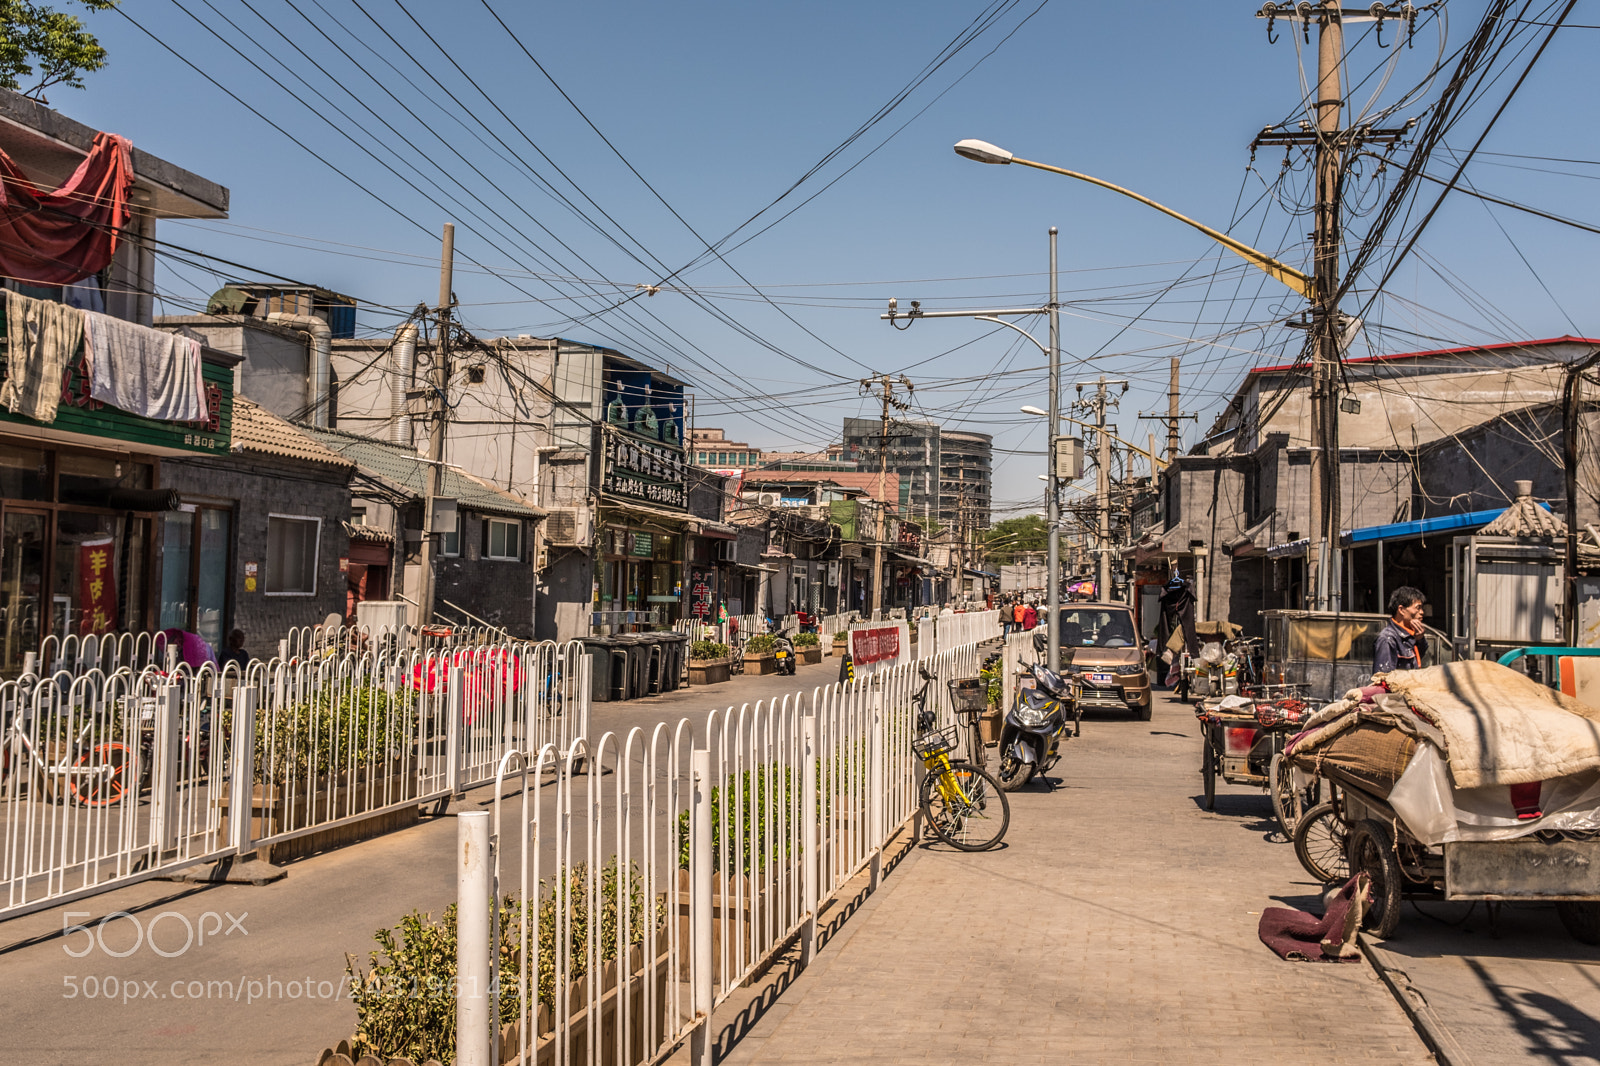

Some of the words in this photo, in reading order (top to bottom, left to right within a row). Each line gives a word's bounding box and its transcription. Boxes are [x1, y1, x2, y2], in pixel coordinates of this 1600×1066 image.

[184, 434, 215, 449] 磁器口店
[692, 582, 711, 626] 牛羊
